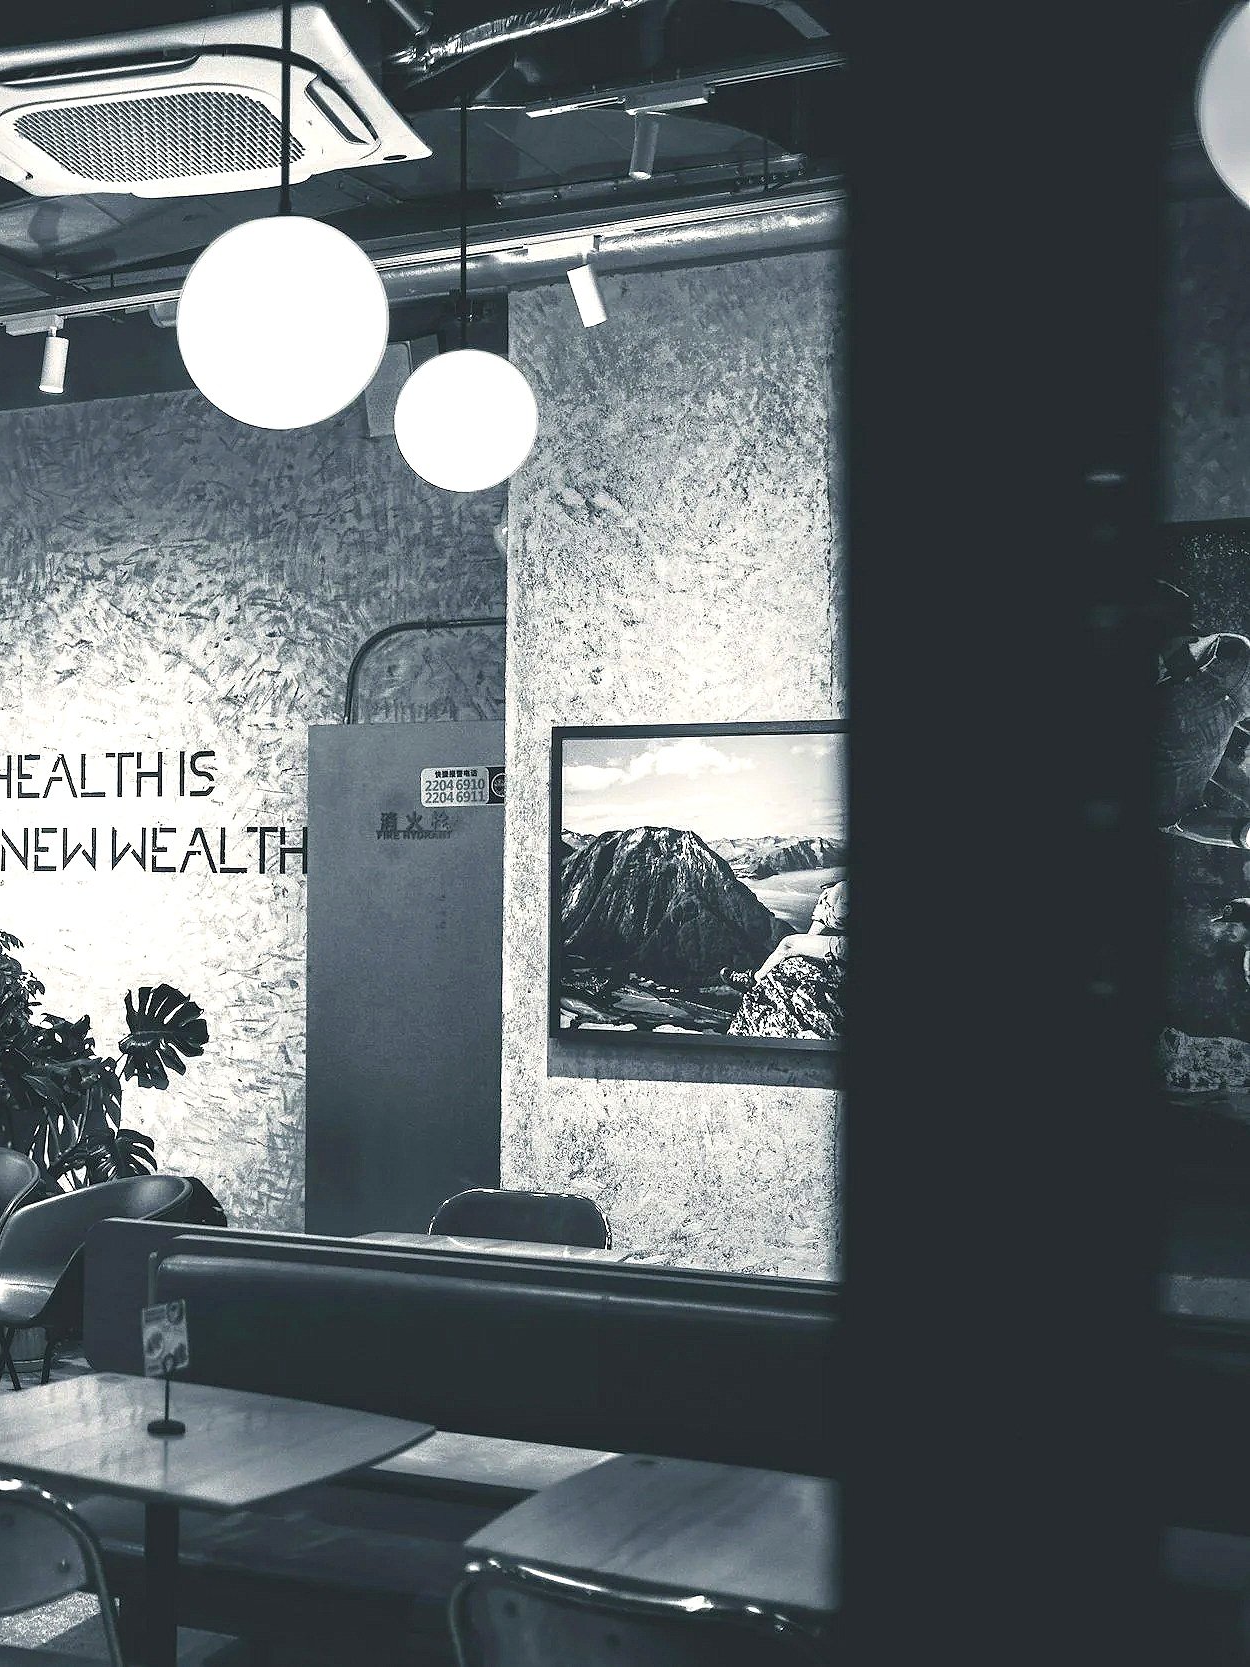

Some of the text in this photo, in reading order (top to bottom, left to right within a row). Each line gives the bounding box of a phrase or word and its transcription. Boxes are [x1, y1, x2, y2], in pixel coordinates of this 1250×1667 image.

[179, 750, 216, 797] IS
[425, 779, 454, 792] 2204
[455, 778, 485, 791] 6910
[425, 790, 486, 804] 2204 6911
[0, 828, 97, 872] NEW
[111, 827, 308, 874] WEALTH
